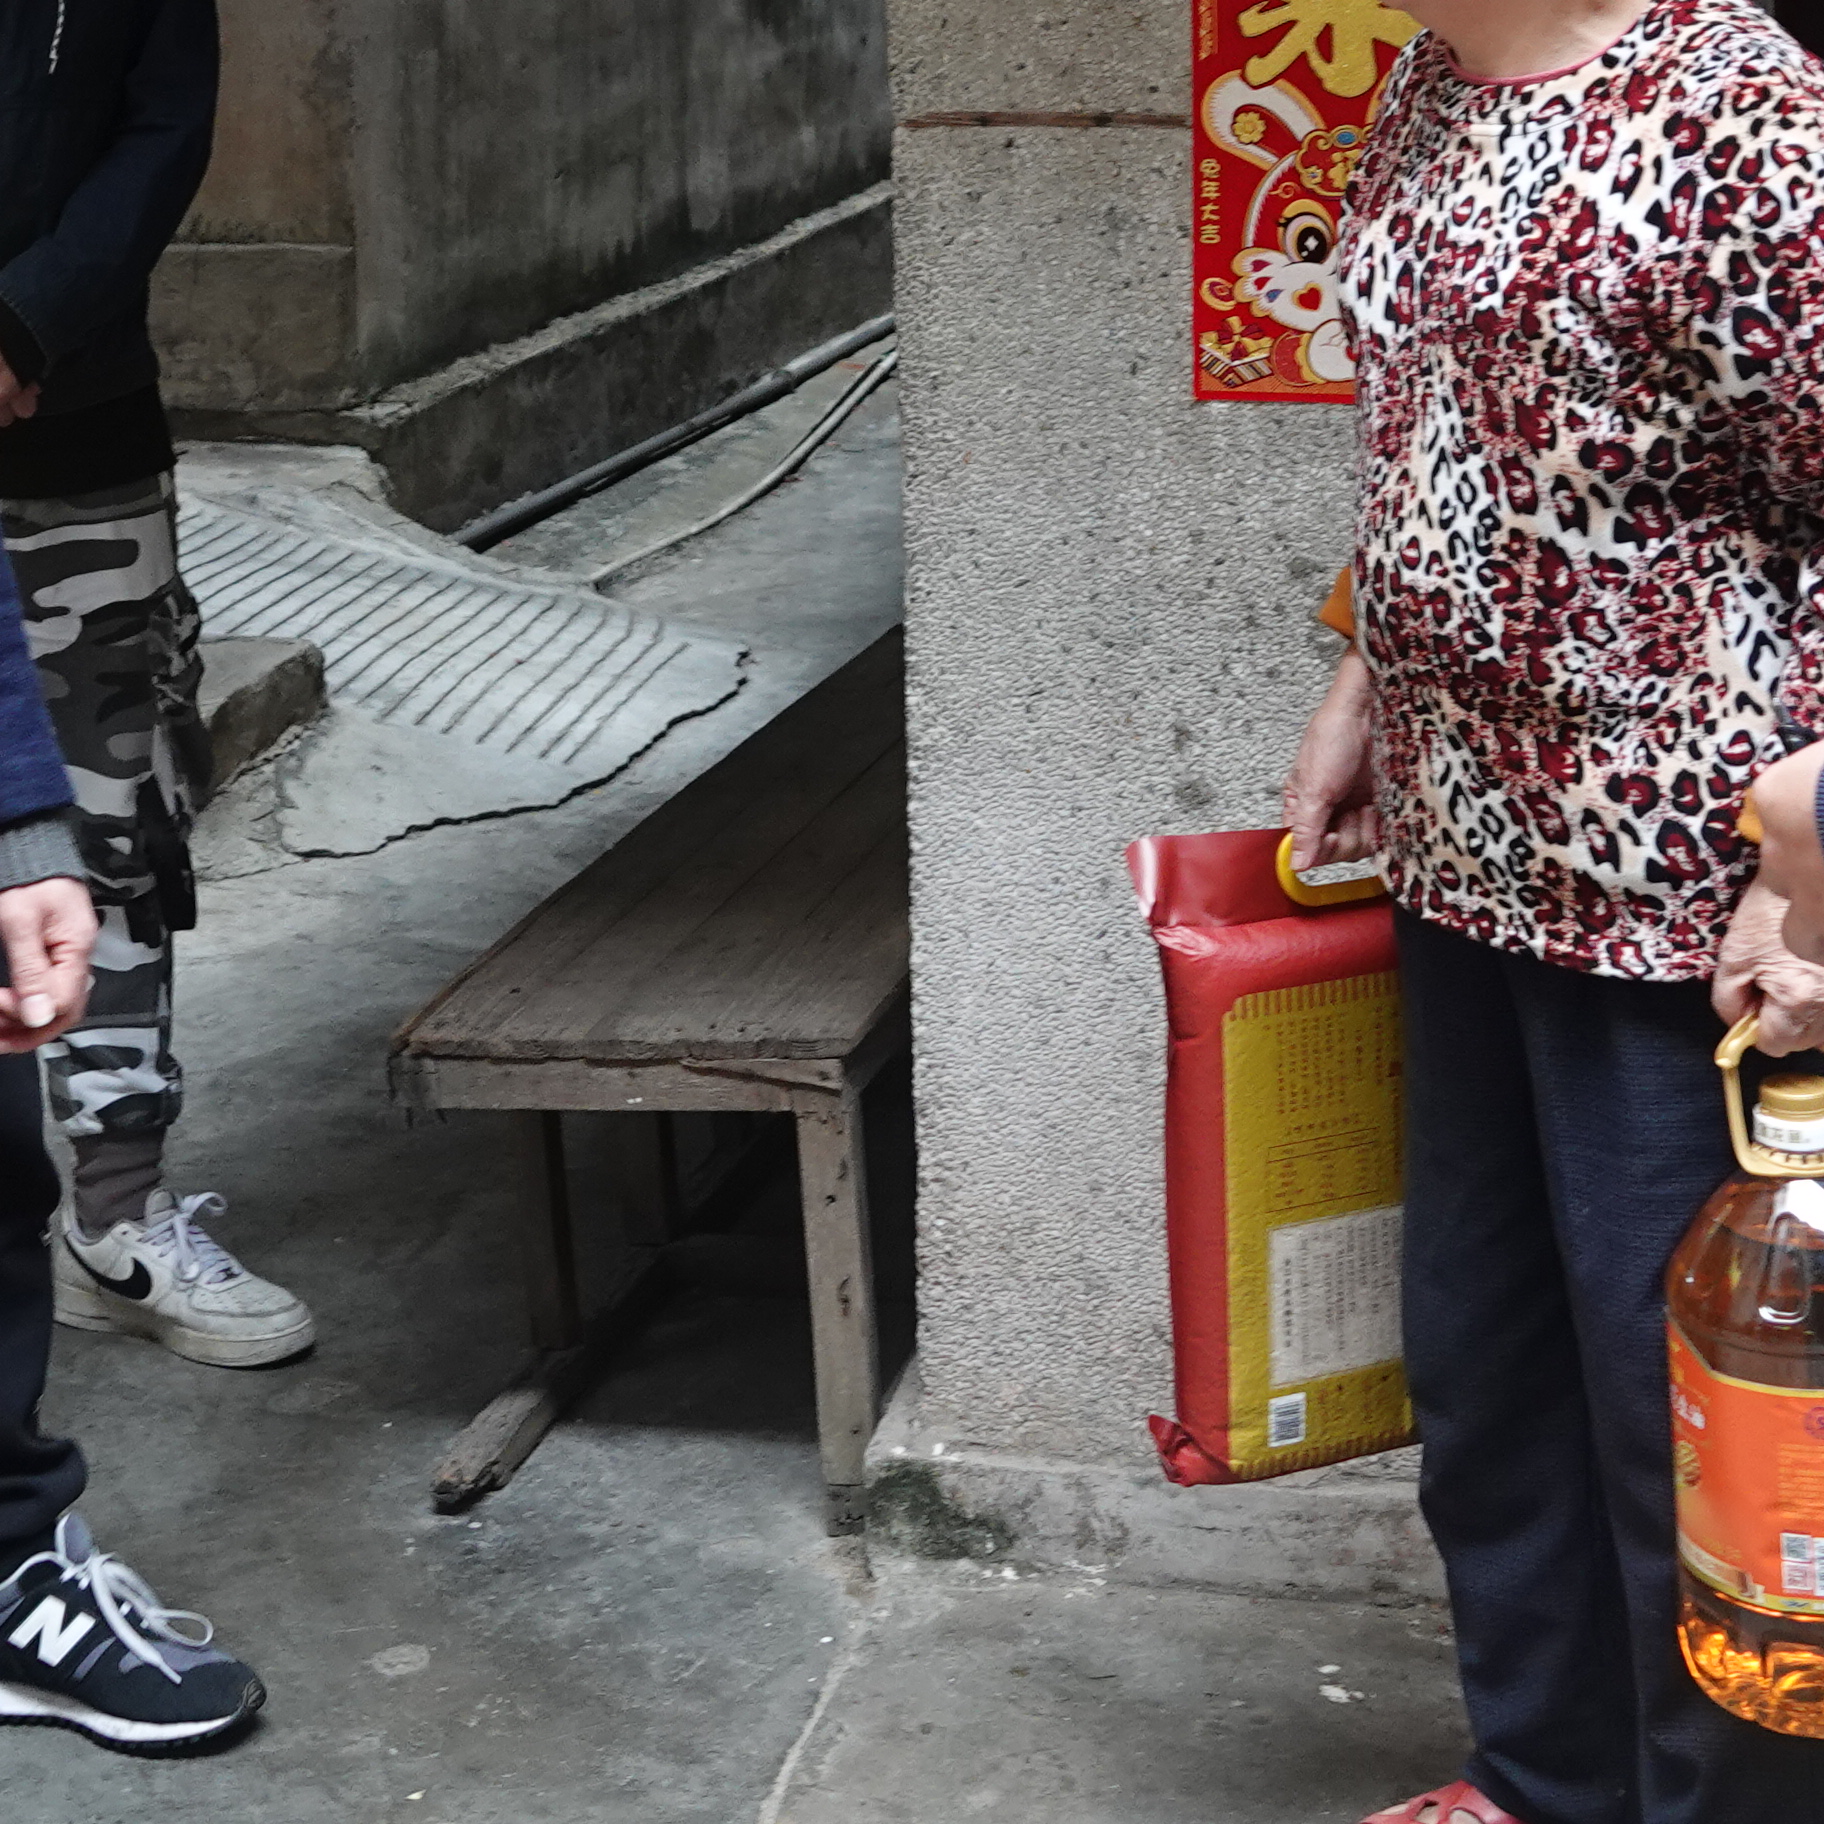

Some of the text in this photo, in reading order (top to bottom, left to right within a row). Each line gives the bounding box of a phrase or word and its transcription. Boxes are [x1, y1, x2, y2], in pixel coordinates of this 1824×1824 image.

[1199, 158, 1222, 244] 兔年大吉
[8, 1595, 96, 1667] N
